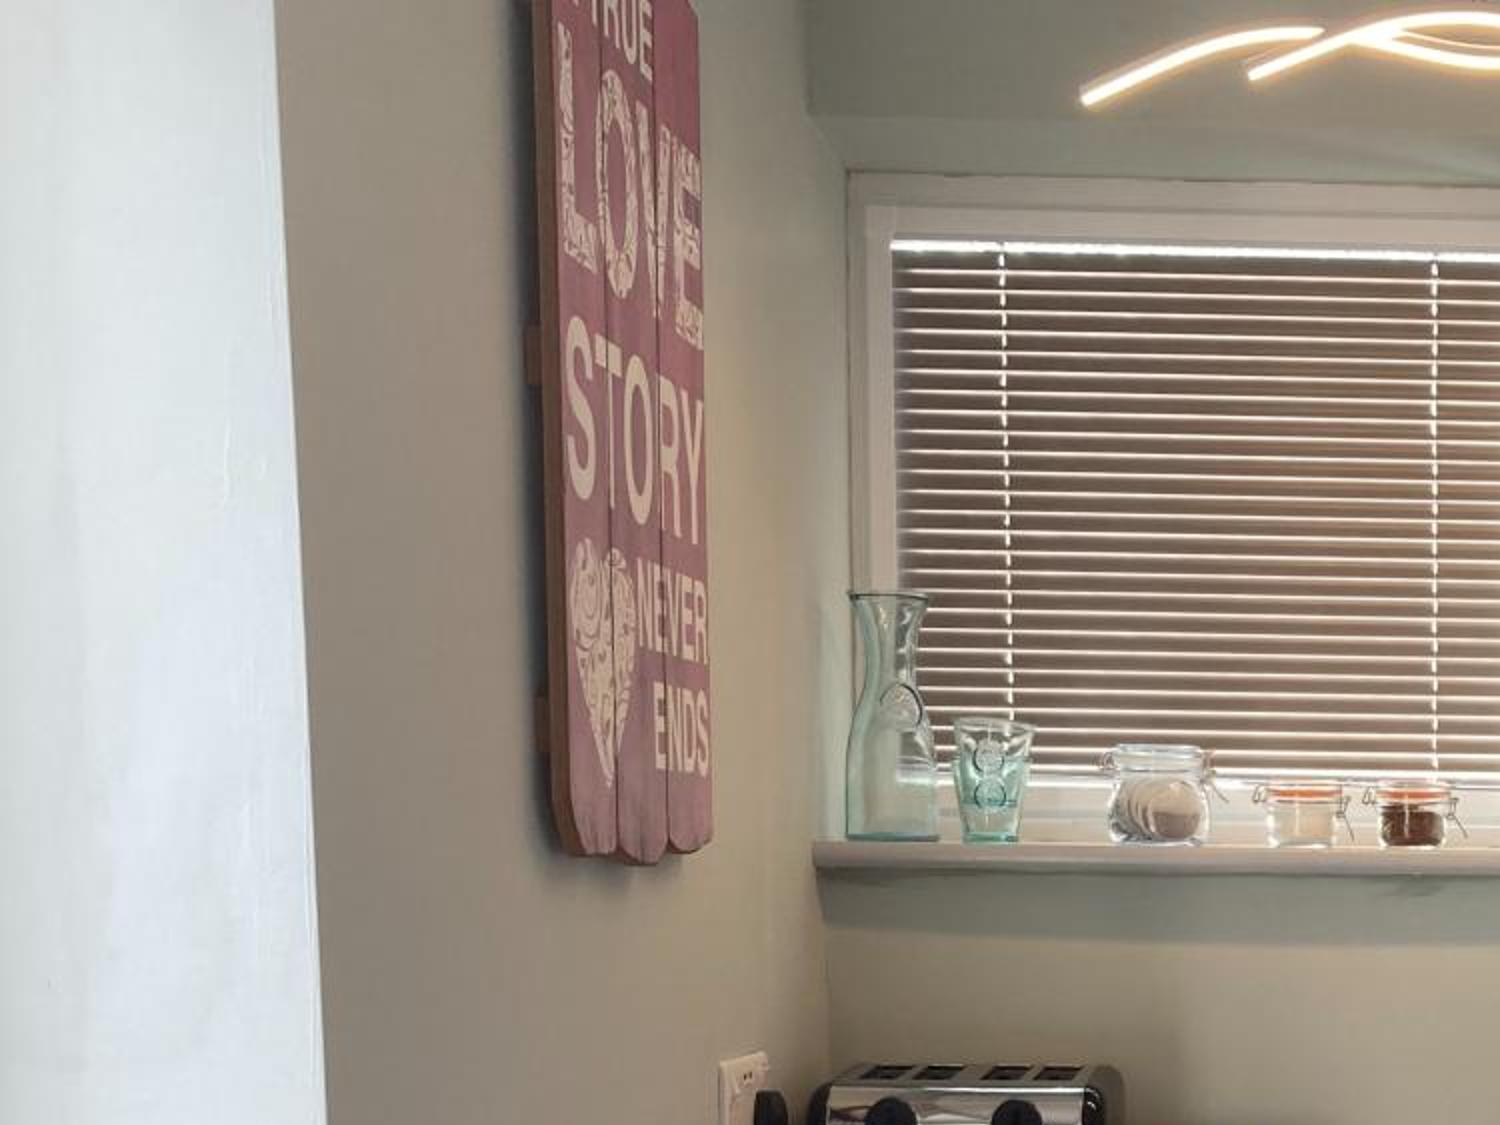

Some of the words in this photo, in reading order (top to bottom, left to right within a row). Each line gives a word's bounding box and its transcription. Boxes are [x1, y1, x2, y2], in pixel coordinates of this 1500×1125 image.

[557, 21, 704, 352] LOVE
[564, 314, 706, 545] STORY
[636, 557, 709, 665] NEVER
[653, 681, 709, 777] ENDS
